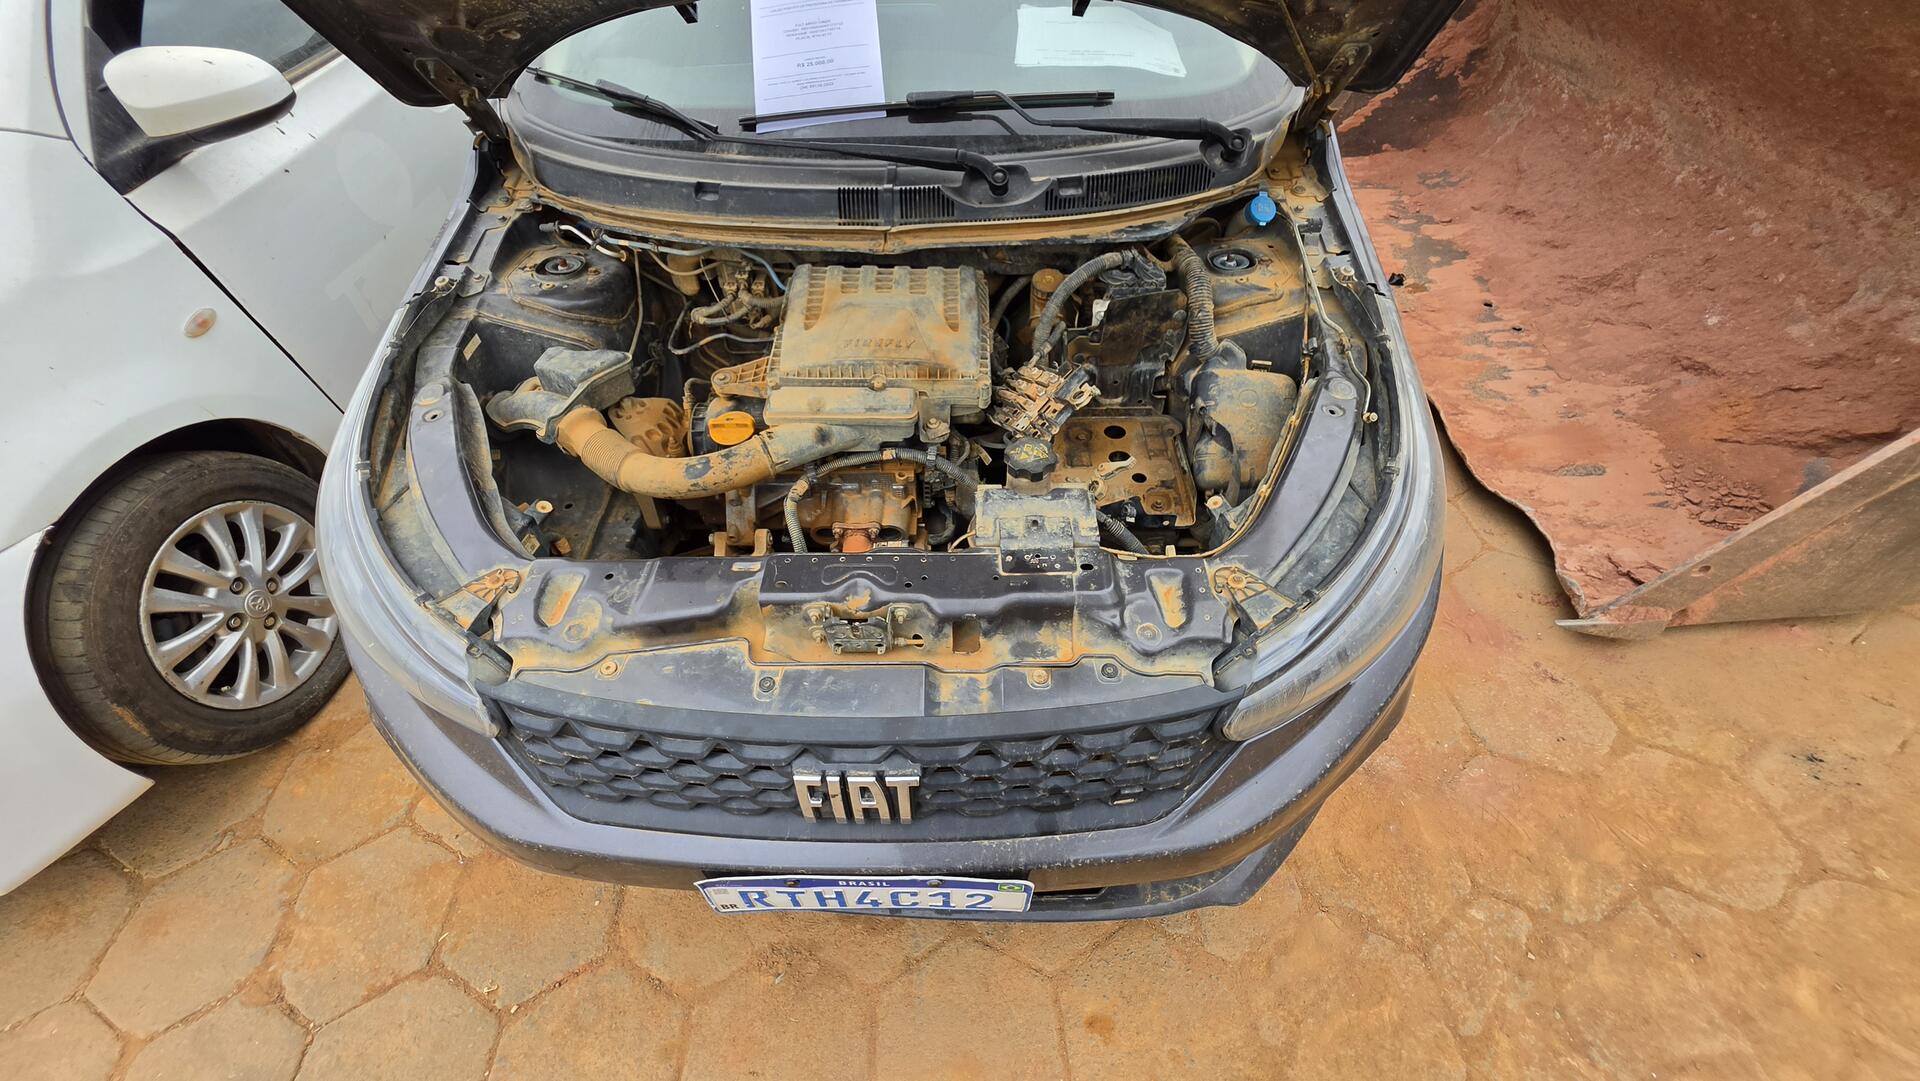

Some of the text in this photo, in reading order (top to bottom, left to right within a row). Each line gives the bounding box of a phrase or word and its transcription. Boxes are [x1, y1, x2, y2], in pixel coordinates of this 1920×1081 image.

[792, 775, 920, 825] FIAT
[720, 903, 739, 911] BR
[738, 889, 994, 910] RTH4C12
